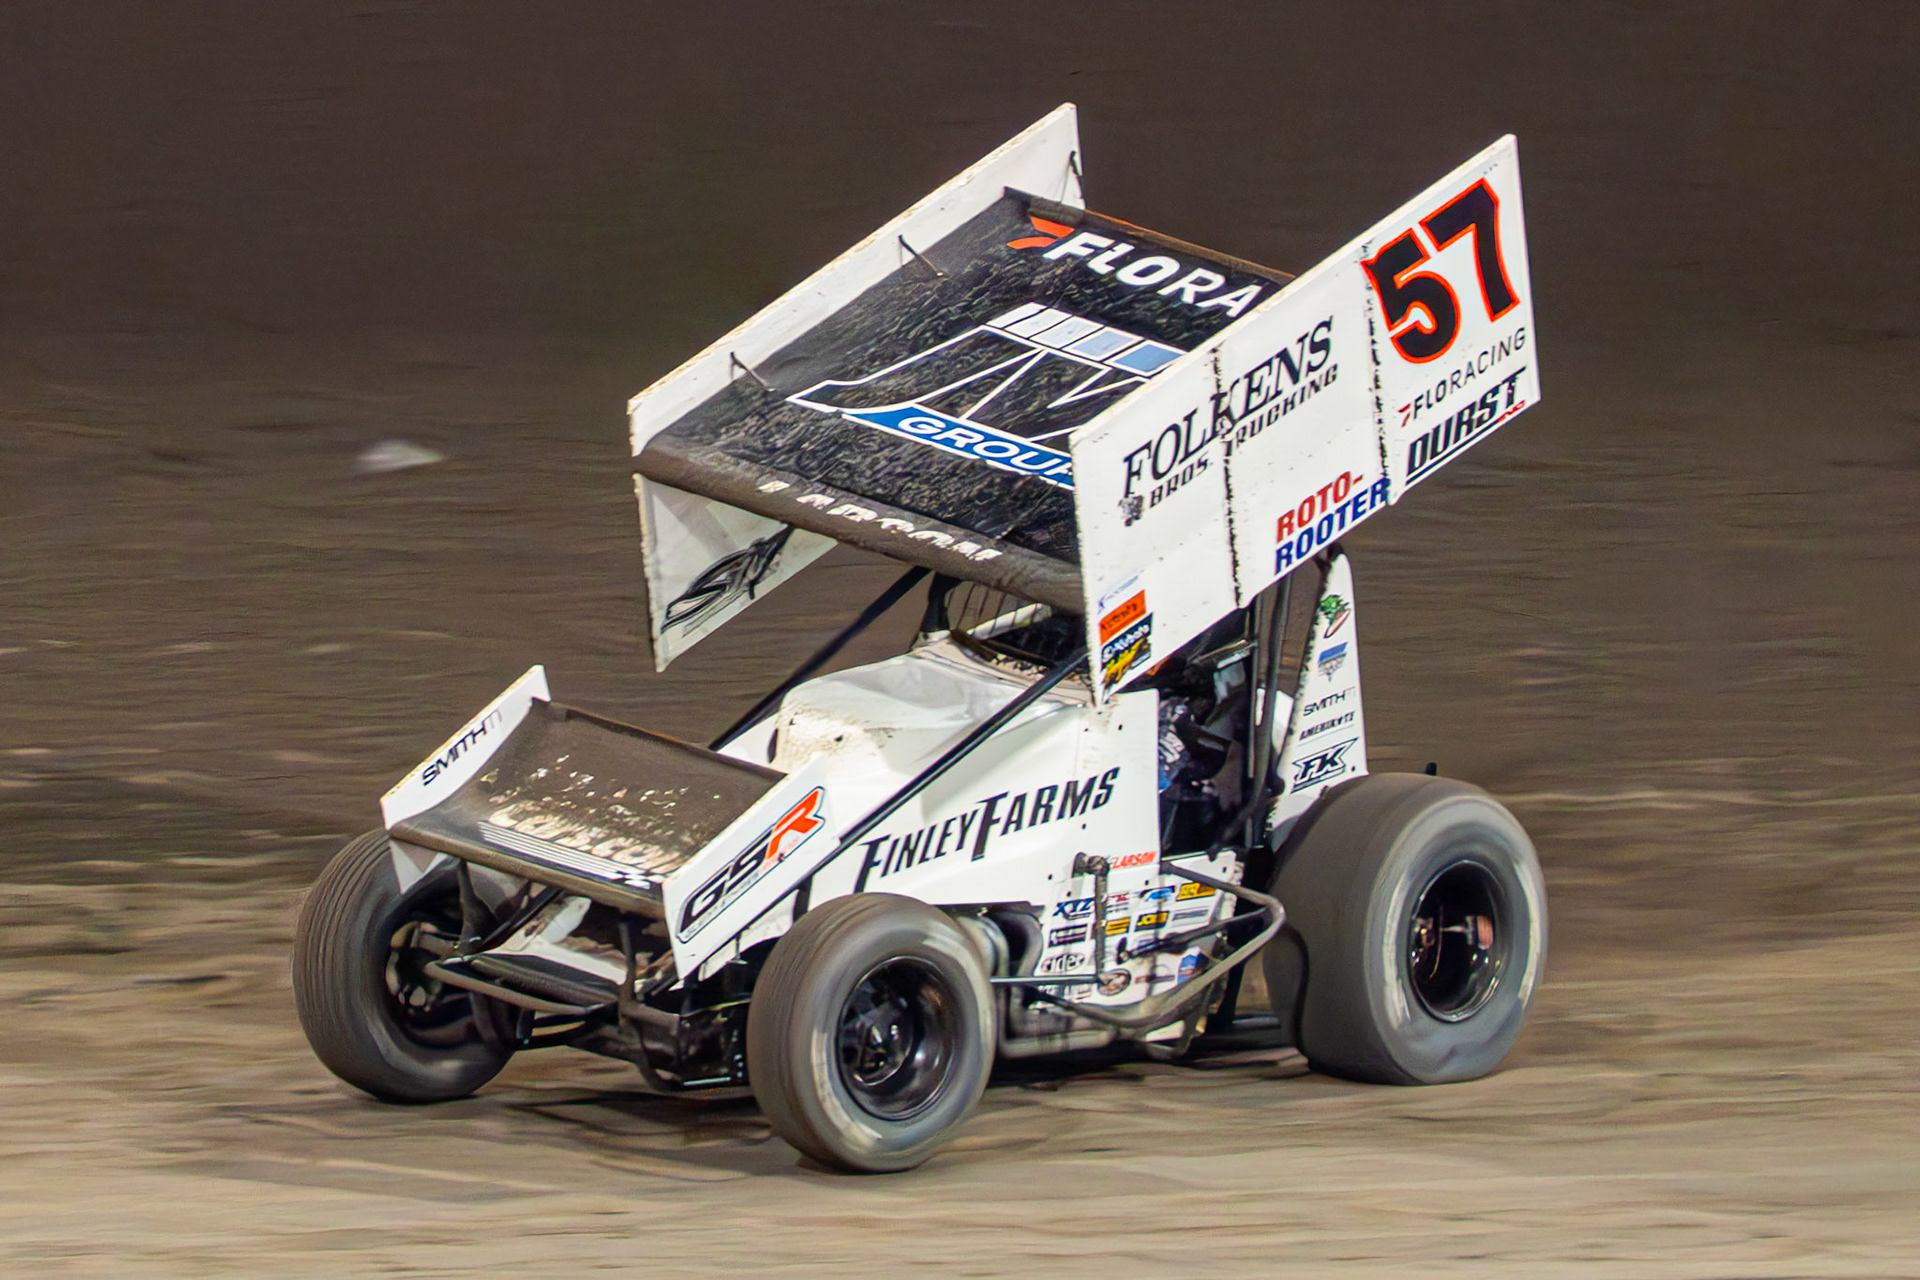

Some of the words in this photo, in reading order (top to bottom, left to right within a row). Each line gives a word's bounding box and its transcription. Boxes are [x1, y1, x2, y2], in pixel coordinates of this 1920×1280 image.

[1360, 177, 1521, 365] 57
[1123, 315, 1333, 498] FOLKENS
[1221, 363, 1338, 457] TRUCKING
[1407, 366, 1527, 477] DURST
[1413, 327, 1526, 420] FLORACING
[1275, 477, 1391, 576] ROOTER
[1277, 471, 1364, 544] ROTO-
[680, 790, 820, 933] GSR
[972, 767, 1120, 862] FARMS
